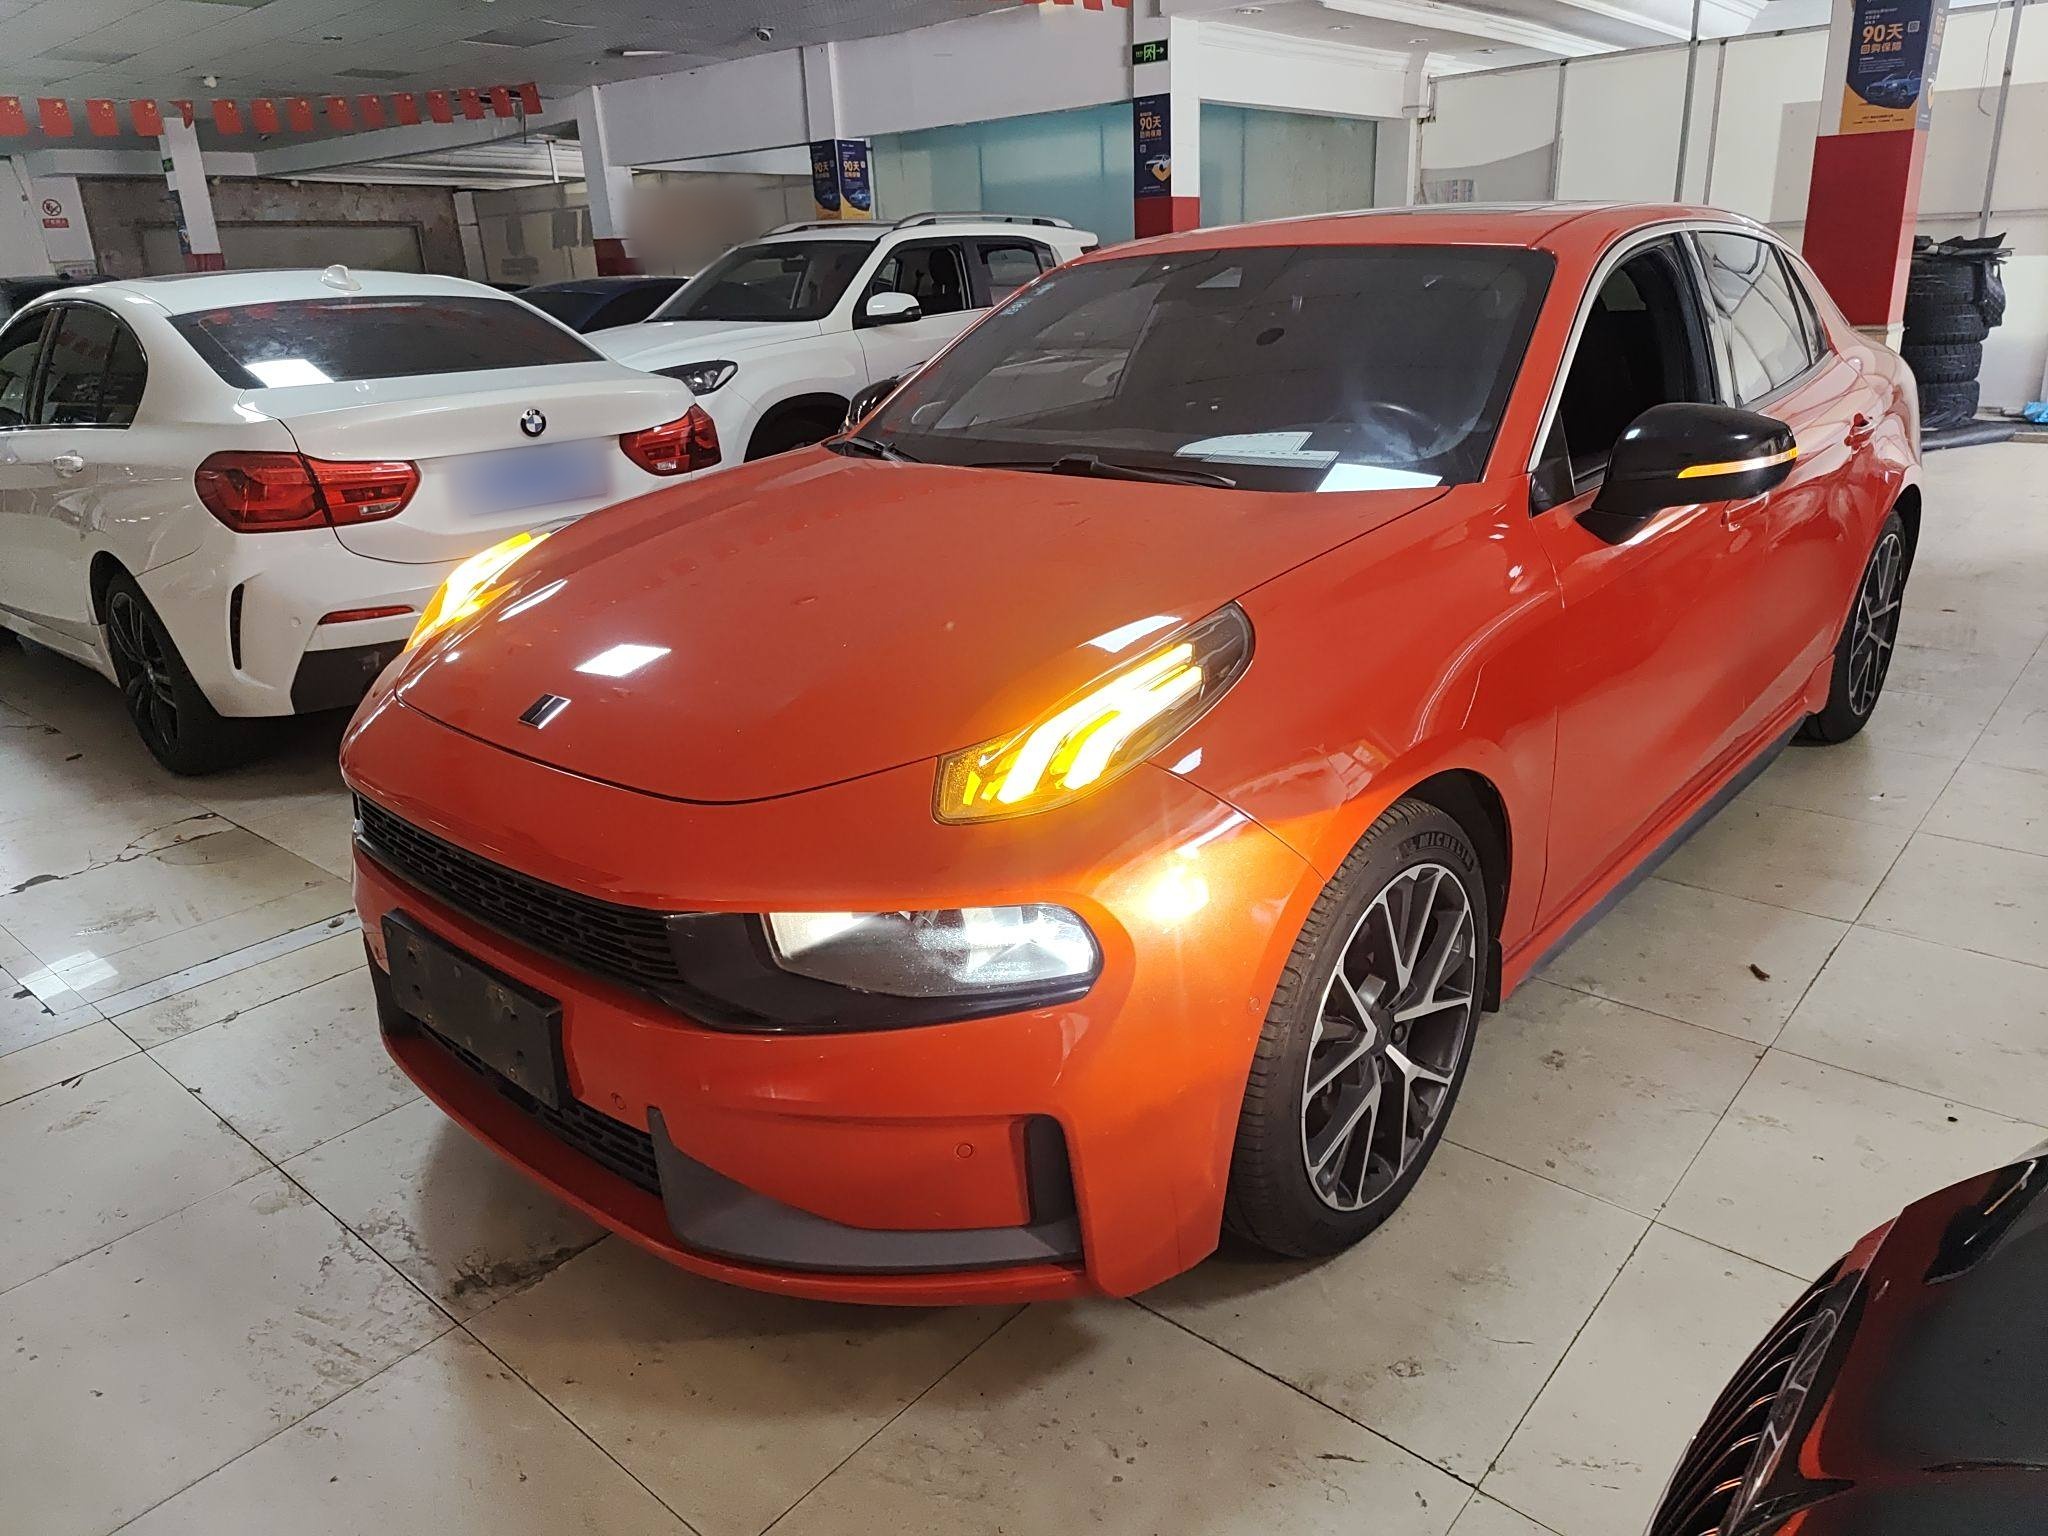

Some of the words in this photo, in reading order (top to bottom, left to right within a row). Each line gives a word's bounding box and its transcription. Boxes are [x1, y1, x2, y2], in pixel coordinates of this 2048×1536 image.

[1862, 24, 1904, 44] 90天
[1139, 115, 1162, 130] 90天
[843, 160, 860, 172] 90天
[1418, 832, 1473, 870] MICHELIN
